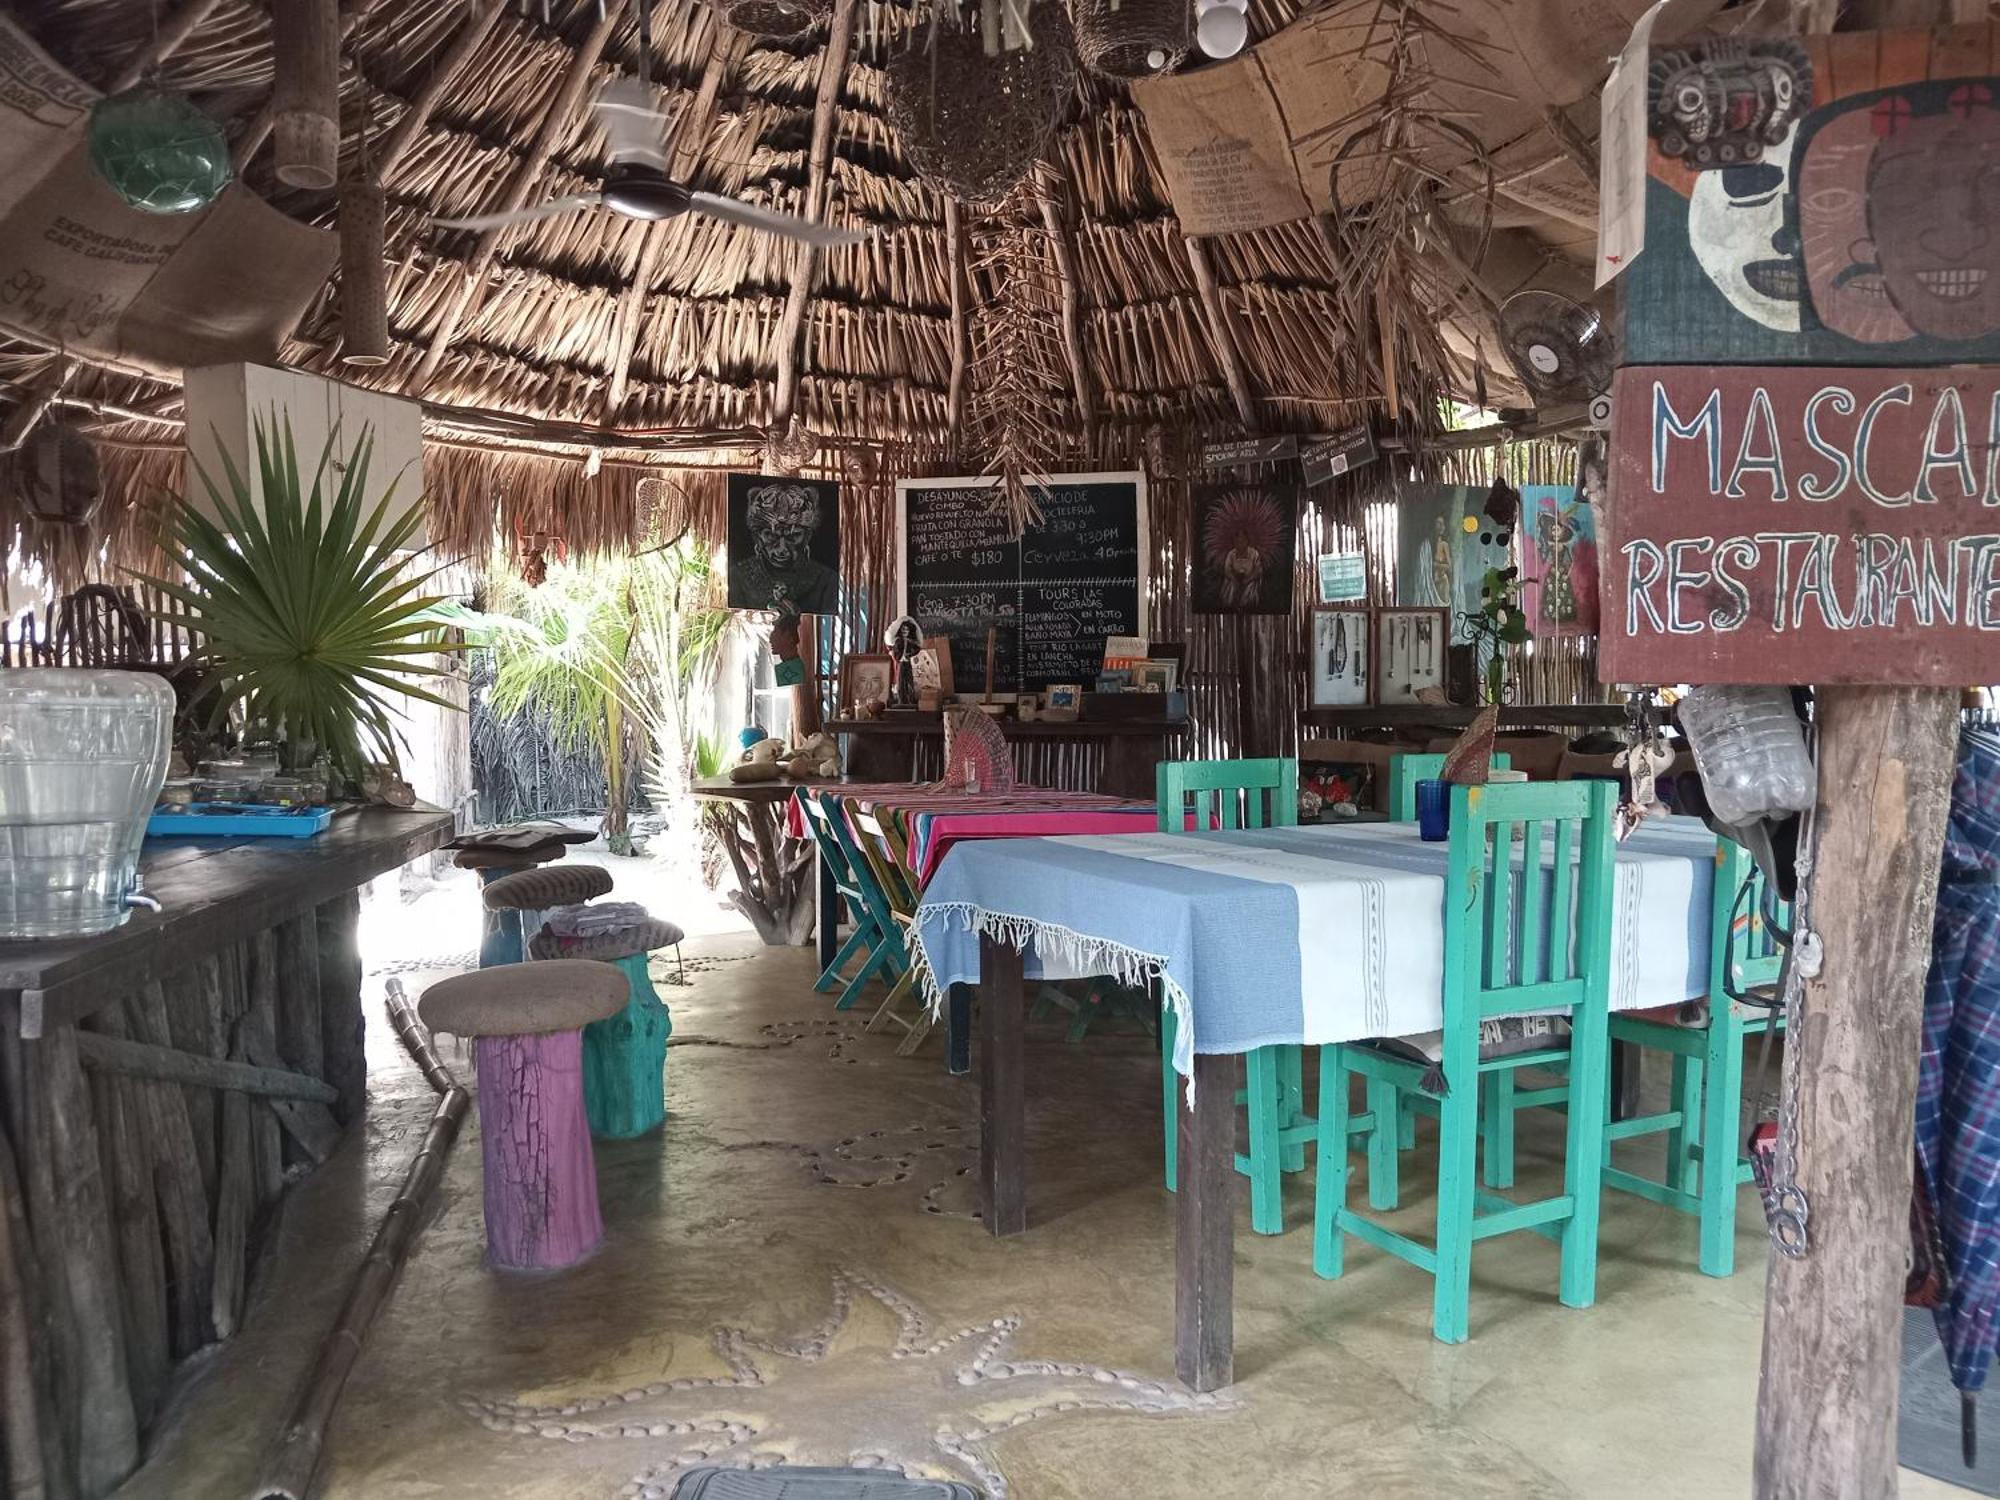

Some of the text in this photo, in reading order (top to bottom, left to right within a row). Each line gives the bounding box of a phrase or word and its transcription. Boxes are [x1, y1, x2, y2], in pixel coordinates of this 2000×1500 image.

[1034, 491, 1073, 505] ERVICIO
[938, 520, 957, 530] CON
[959, 518, 1003, 529] GRANOLA
[971, 550, 1002, 567] $180
[1620, 531, 2000, 637] RESTAURANTE
[1038, 588, 1078, 600] TOURS
[1053, 599, 1103, 610] COLORADAS
